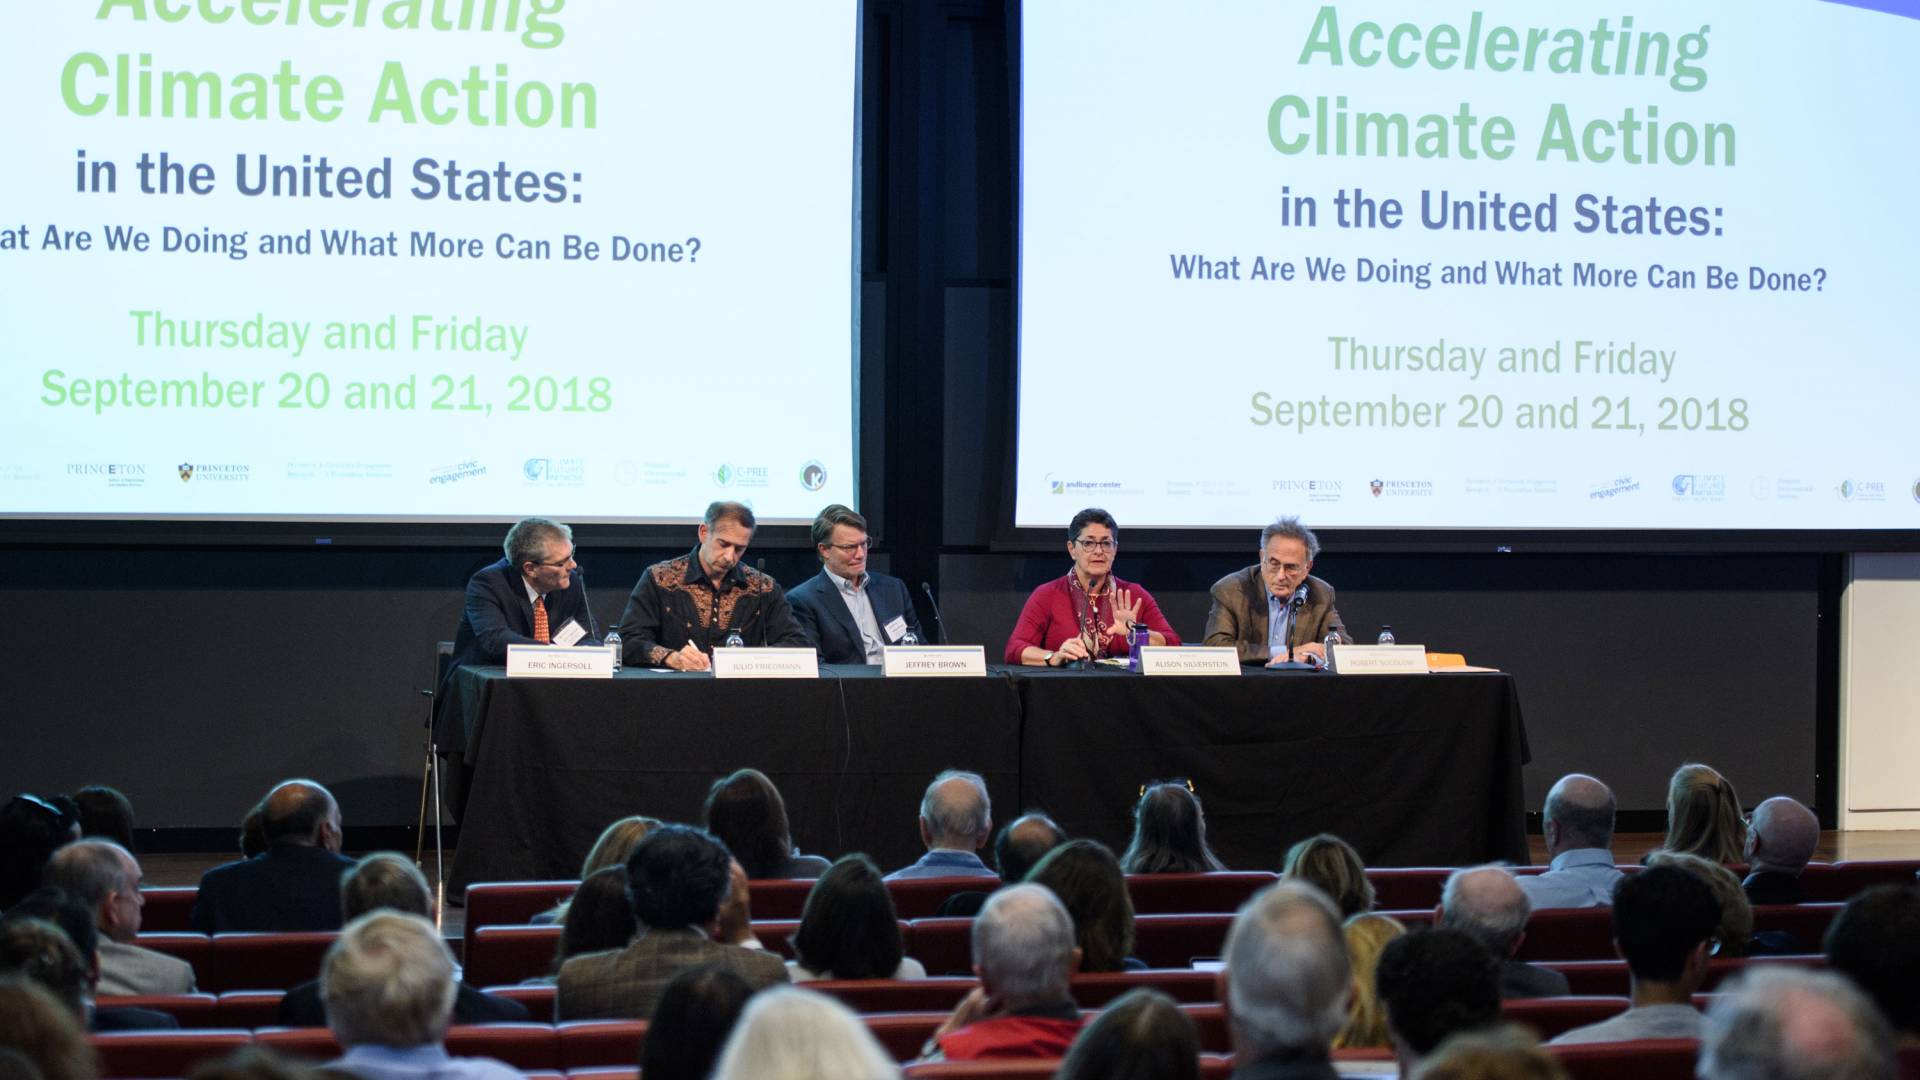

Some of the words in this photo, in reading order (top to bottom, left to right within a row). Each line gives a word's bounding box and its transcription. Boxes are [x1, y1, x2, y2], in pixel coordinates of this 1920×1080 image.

[96, 0, 565, 49] eerang
[1298, 6, 1711, 92] Accelerating
[61, 53, 344, 122] Climate
[368, 61, 596, 128] Action
[1268, 95, 1515, 160] Climate
[1537, 104, 1735, 166] Action
[77, 149, 116, 192] in
[136, 152, 215, 195] the
[237, 154, 391, 199] United
[411, 158, 581, 203] States:
[1282, 186, 1316, 226] in
[1334, 188, 1403, 229] the
[1422, 190, 1557, 232] United
[1574, 194, 1722, 236] States:
[42, 225, 91, 250] Are
[104, 225, 149, 251] We
[163, 226, 248, 260] Doing
[259, 229, 311, 254] and
[321, 230, 397, 256] What
[411, 232, 483, 258] More
[496, 233, 550, 259] Can
[564, 235, 599, 260] Be
[613, 236, 701, 262] Done?
[1170, 254, 1240, 280] What
[1251, 256, 1295, 281] Are
[1306, 257, 1346, 282] We
[1357, 258, 1431, 289] Doing
[1441, 261, 1486, 284] and
[1495, 261, 1562, 286] What
[1574, 263, 1637, 287] More
[1648, 264, 1695, 288] Can
[1707, 266, 1738, 290] Be
[1750, 267, 1826, 291] Done?
[129, 311, 310, 357] Thursday
[324, 315, 395, 351] and
[412, 315, 528, 361] Friday
[1328, 336, 1486, 380] Thursday
[1498, 340, 1560, 373] and
[1575, 340, 1676, 383] Friday
[41, 369, 264, 415] September
[278, 372, 330, 409] 20
[344, 375, 416, 410] and
[432, 374, 492, 415] 21,
[507, 375, 612, 412] 2018
[1250, 392, 1446, 433] September
[1458, 394, 1503, 428] 20
[1516, 396, 1577, 429] and
[1591, 396, 1644, 432] 21,
[1658, 397, 1749, 431] 2018
[67, 464, 145, 475] PRINCETON
[196, 464, 249, 472] PRINCETON
[458, 459, 478, 471] civic
[196, 473, 249, 481] UNIVERSITY
[429, 466, 487, 485] engagement
[1386, 480, 1433, 488] PRINCETON
[1614, 476, 1632, 486] civic
[1099, 481, 1121, 489] center
[1272, 480, 1343, 490] PRINCETON
[1386, 489, 1433, 497] UNIVERSITY
[1589, 481, 1640, 499] engagement
[528, 661, 546, 670] ERIC
[548, 662, 593, 671] INGERSOLL
[754, 663, 802, 671] FRIEDMANN
[905, 661, 935, 669] JEFFREY
[938, 661, 967, 669] BROWN
[1155, 660, 1182, 668] ALISON
[1183, 660, 1229, 669] SILVERSTEIN
